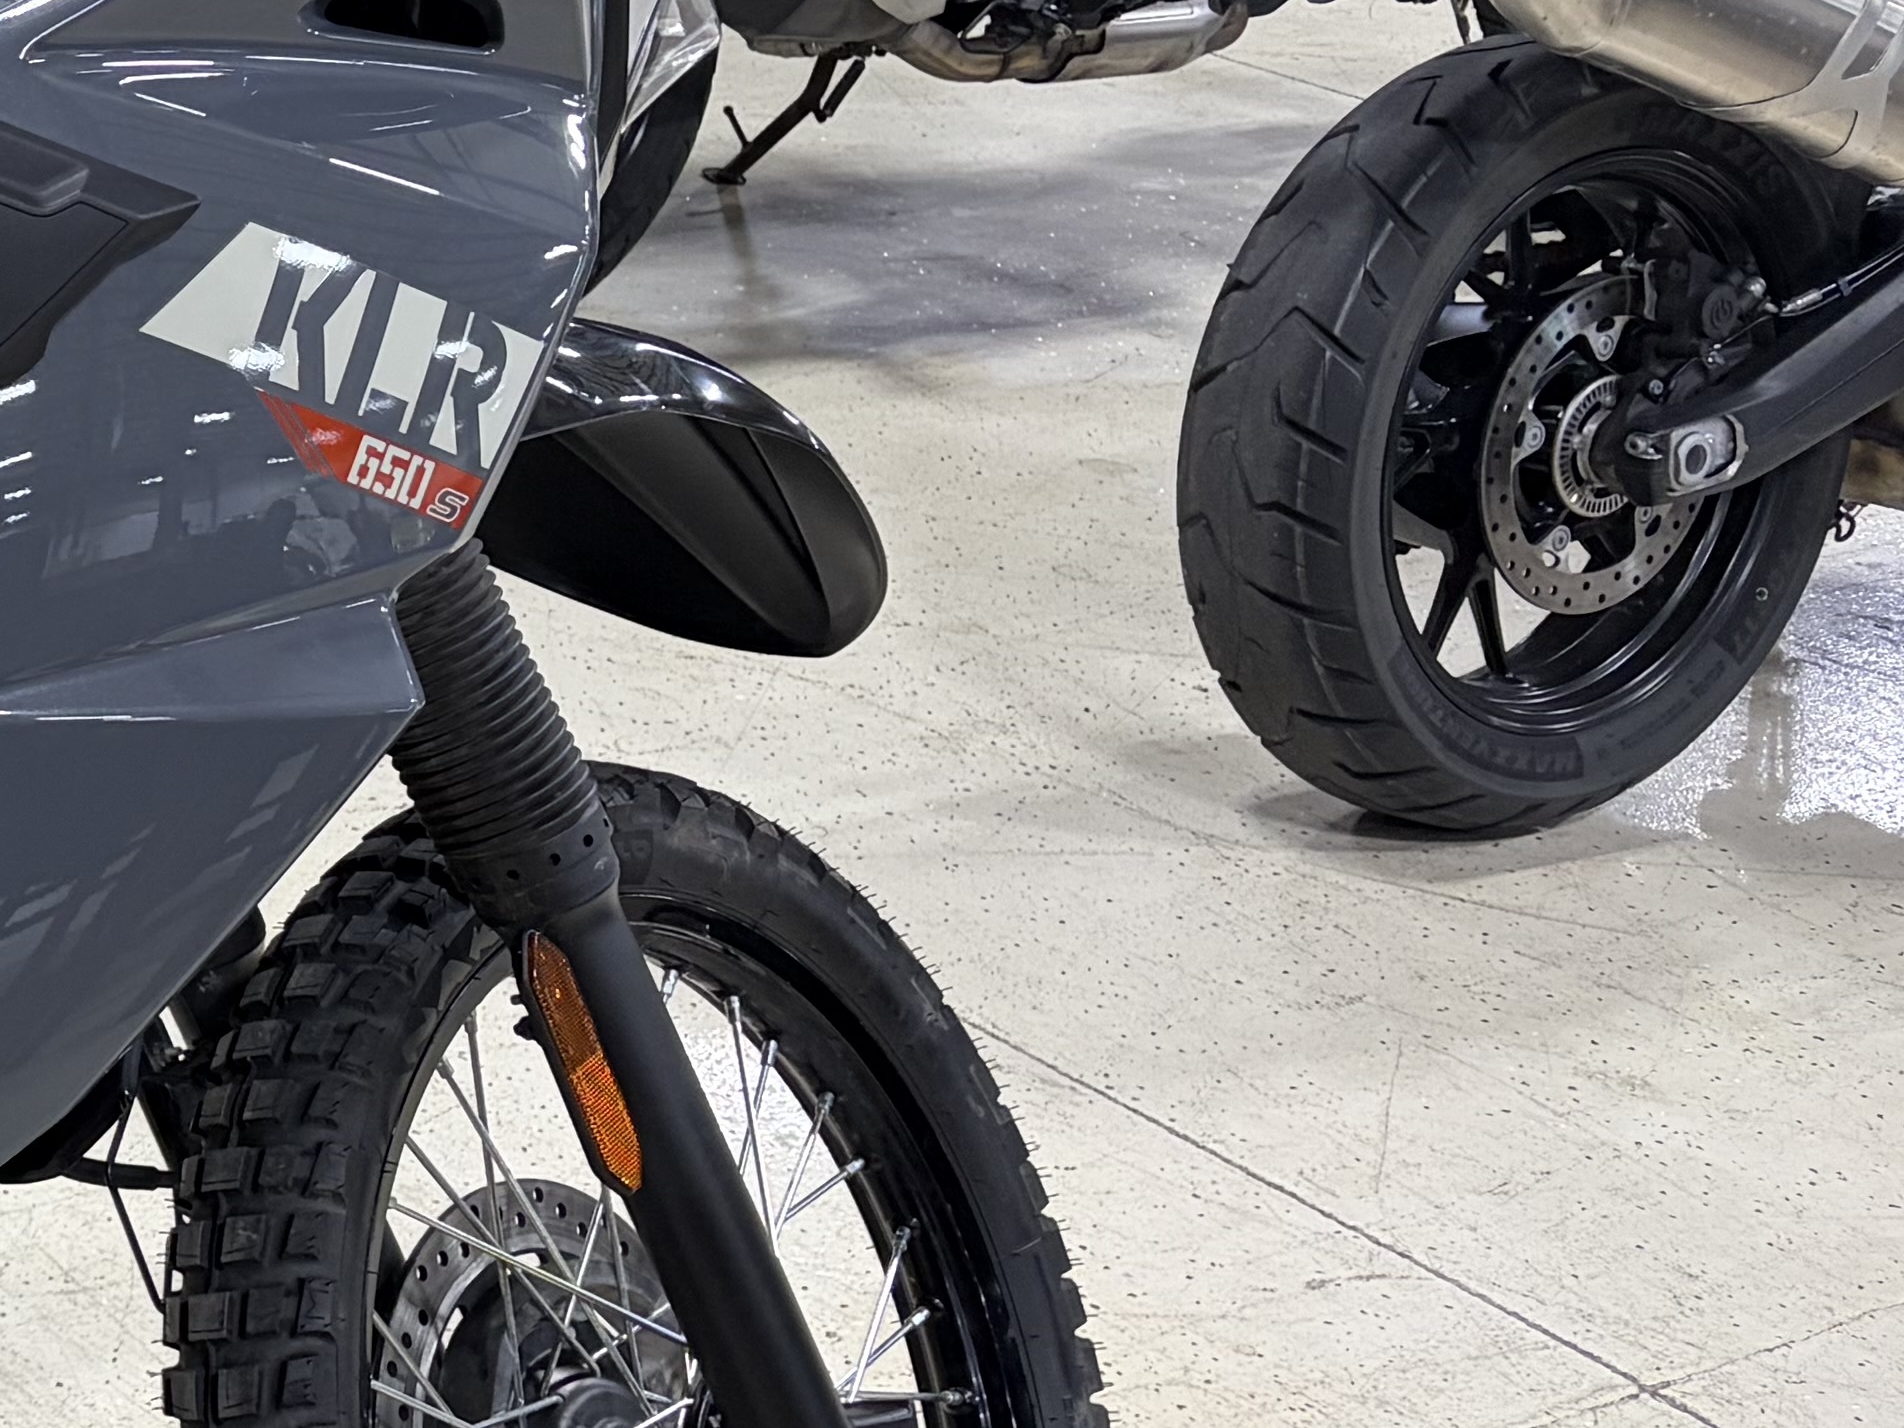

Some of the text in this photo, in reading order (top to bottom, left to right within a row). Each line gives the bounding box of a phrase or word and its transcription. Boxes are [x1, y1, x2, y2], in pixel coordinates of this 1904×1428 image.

[248, 240, 510, 472] KLR
[346, 434, 471, 523] 650 S
